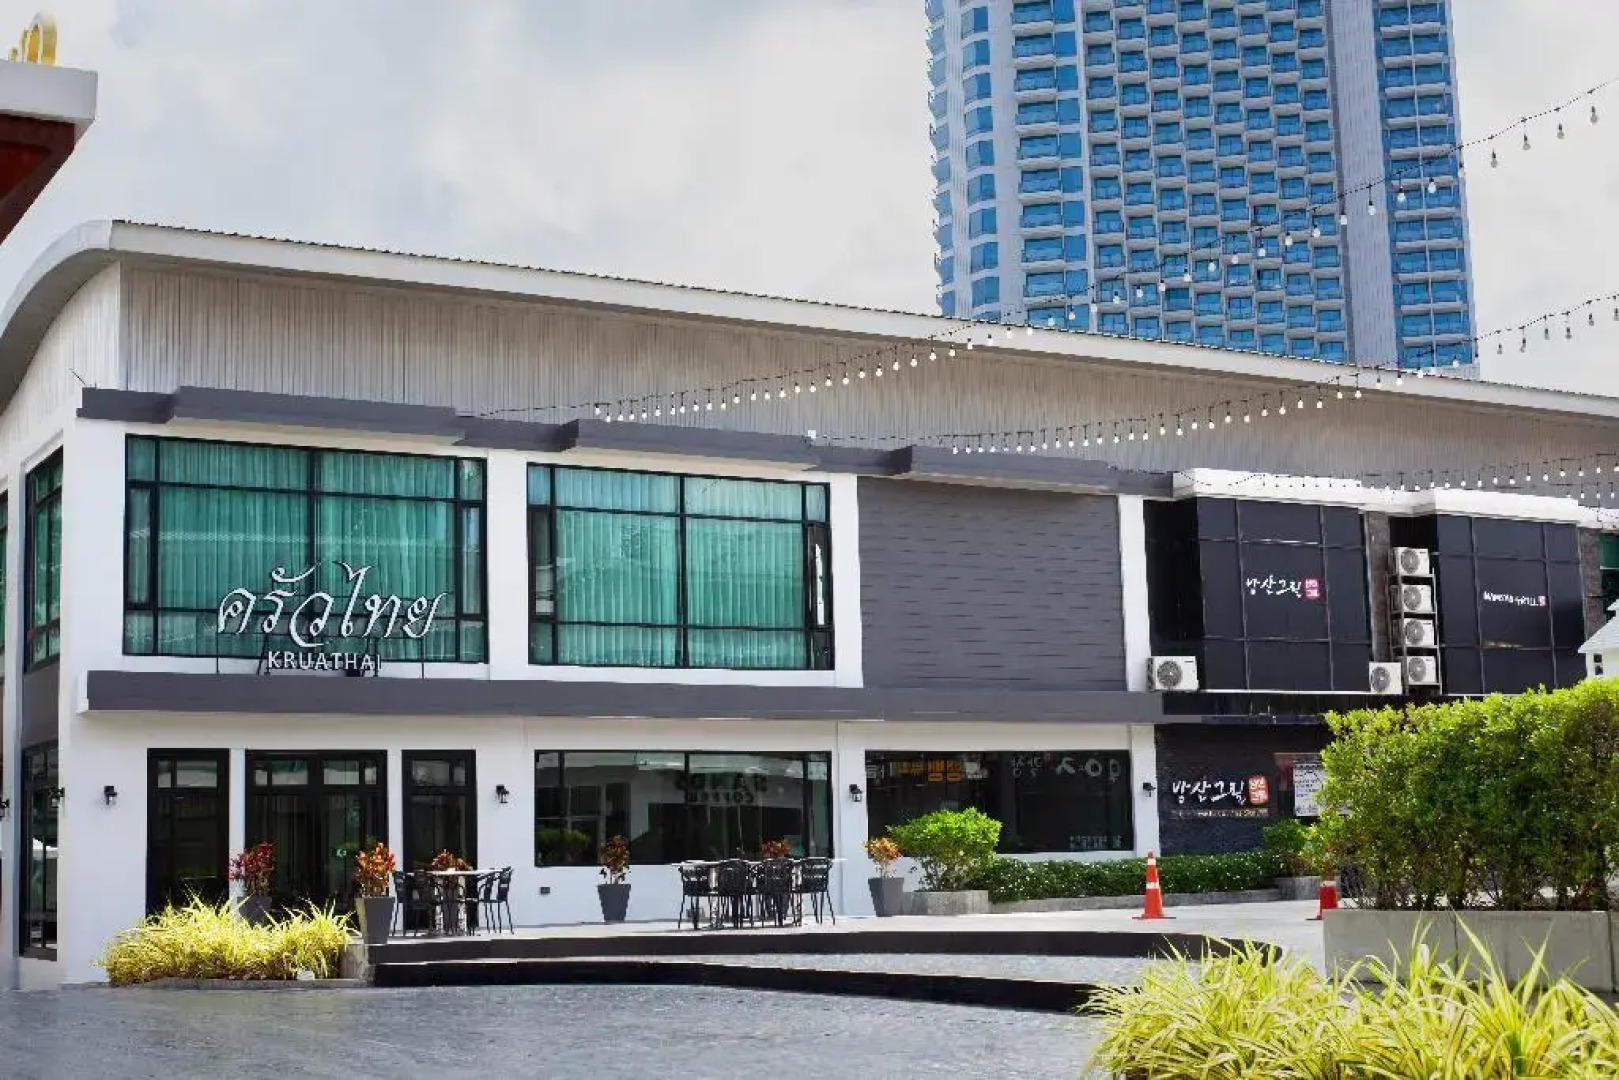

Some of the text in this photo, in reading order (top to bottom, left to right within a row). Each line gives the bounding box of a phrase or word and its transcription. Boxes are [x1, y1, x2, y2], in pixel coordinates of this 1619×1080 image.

[217, 560, 451, 648] ครัวไทย
[268, 651, 382, 671] KRUATHAI
